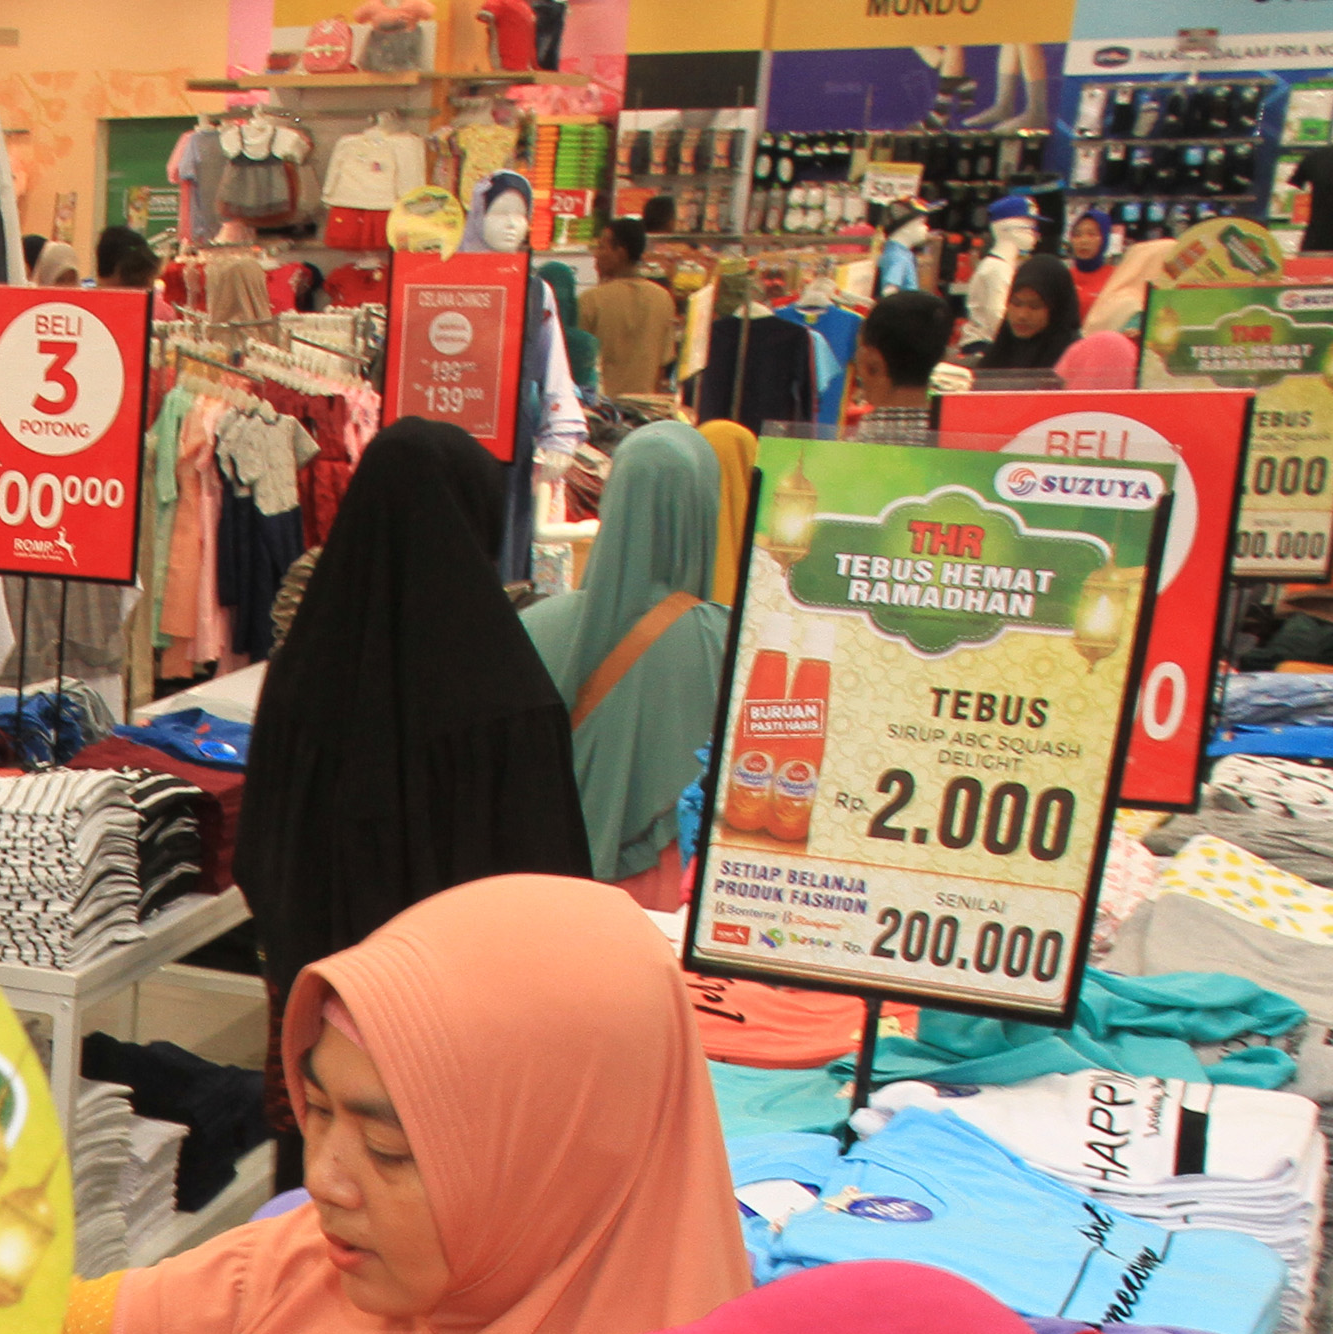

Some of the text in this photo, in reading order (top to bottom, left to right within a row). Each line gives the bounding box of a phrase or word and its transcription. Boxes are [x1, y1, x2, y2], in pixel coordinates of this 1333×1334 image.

[35, 314, 82, 336] BELI
[31, 338, 79, 416] 3
[19, 418, 90, 439] POTONG
[1045, 430, 1129, 460] BELI
[1040, 475, 1153, 500] SUZUYA
[1242, 456, 1328, 496] .000
[908, 520, 986, 559] THR
[1235, 531, 1326, 559] 00.000
[835, 553, 1056, 594] TEBUS HEMAT
[847, 578, 1034, 618] RAMADHAN
[750, 705, 818, 720] BURUAN
[930, 686, 1049, 729] TEBUS
[750, 720, 782, 731] PASTI
[887, 722, 1082, 758] SIRUP ABC SQUASH
[938, 749, 1022, 772] DELIGHT
[867, 767, 1075, 861] 2.000
[719, 859, 867, 894] SETIAP BELANJA
[713, 878, 868, 915] PRODUK FASHION
[936, 891, 1007, 914] SENILAI
[870, 906, 1064, 982] 200.000
